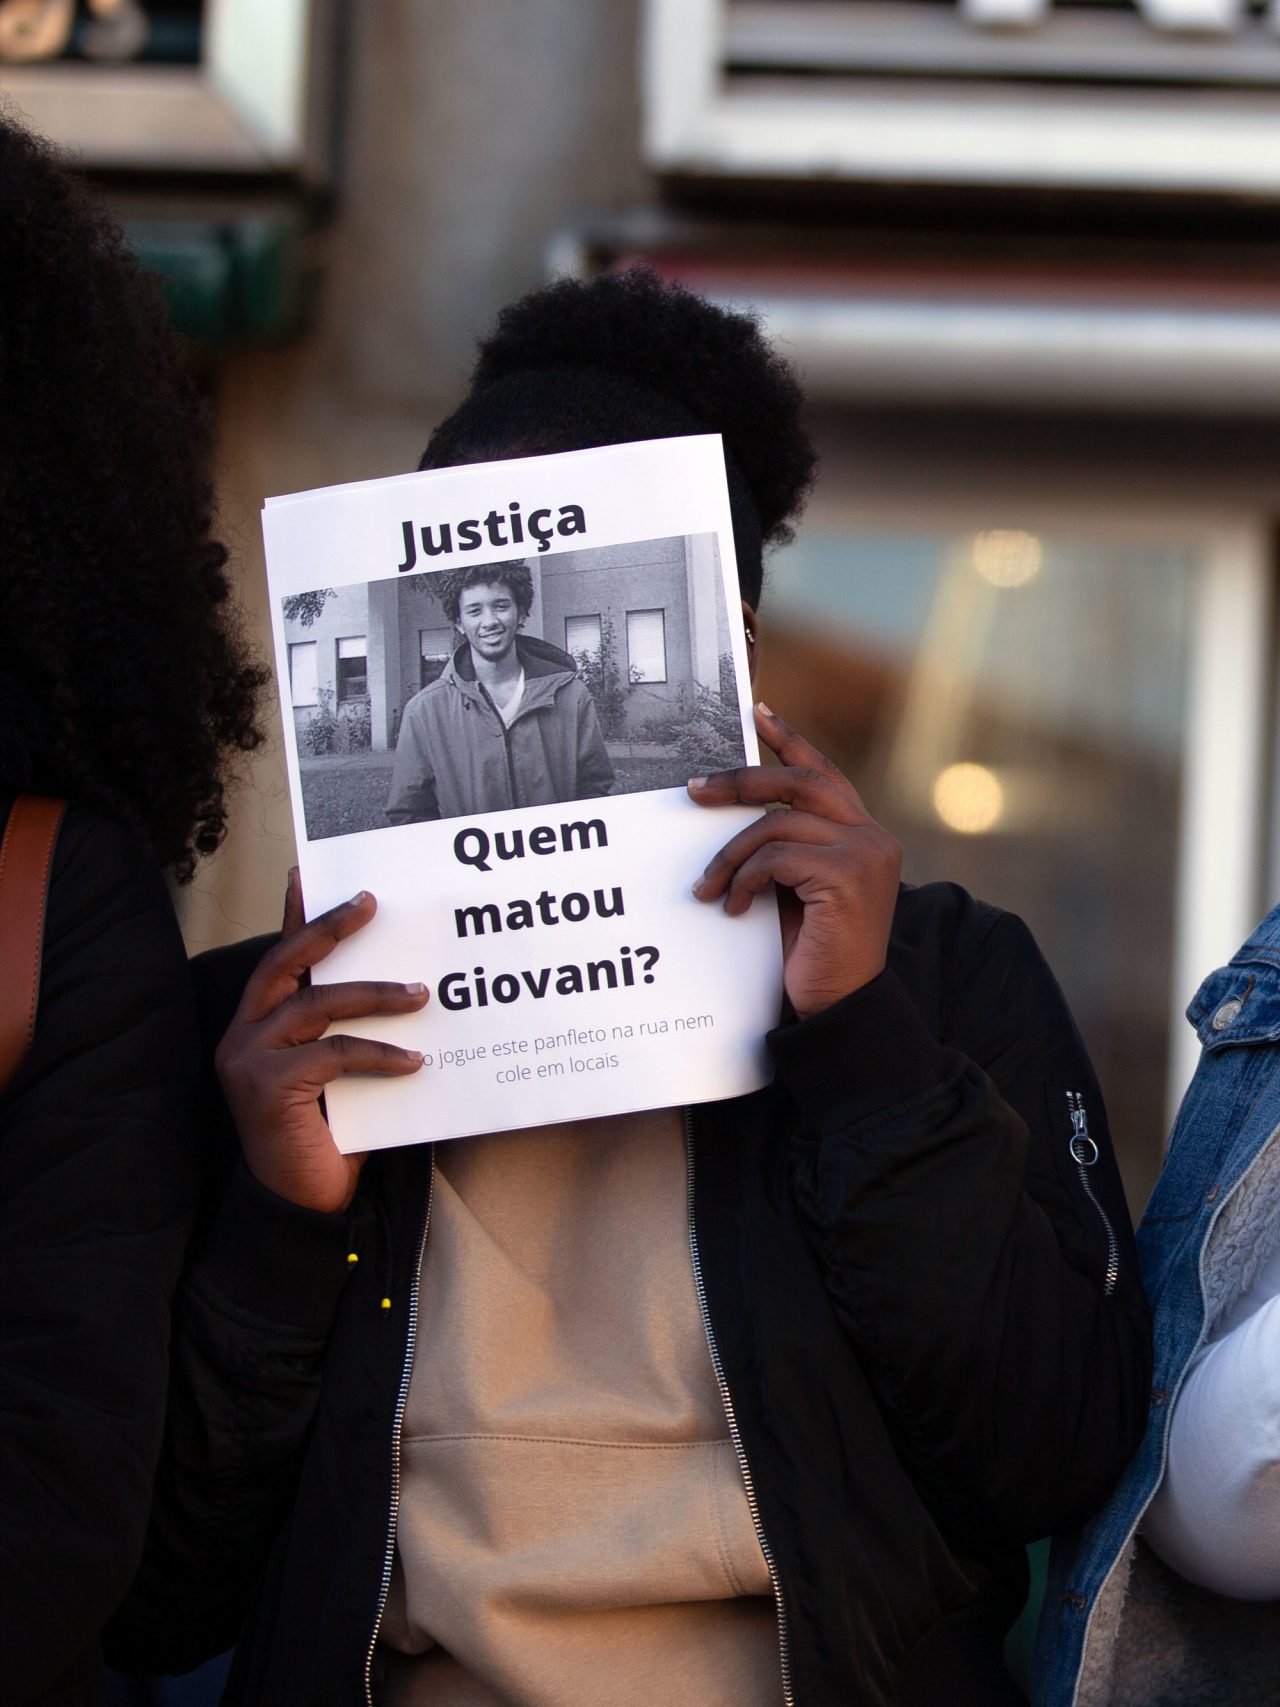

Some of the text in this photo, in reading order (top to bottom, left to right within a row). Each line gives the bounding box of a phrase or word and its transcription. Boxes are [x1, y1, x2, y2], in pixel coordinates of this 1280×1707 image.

[398, 501, 588, 573] Justiça
[453, 818, 608, 872] Quem
[454, 886, 625, 938] matou
[437, 945, 660, 1011] Giovani?
[438, 1046, 487, 1069] jogue
[491, 1040, 529, 1057] este
[533, 1028, 608, 1056] panfleto
[611, 1022, 634, 1039] na
[639, 1020, 669, 1036] rua
[674, 1012, 714, 1031] nem
[495, 1052, 620, 1084] cole em locais
